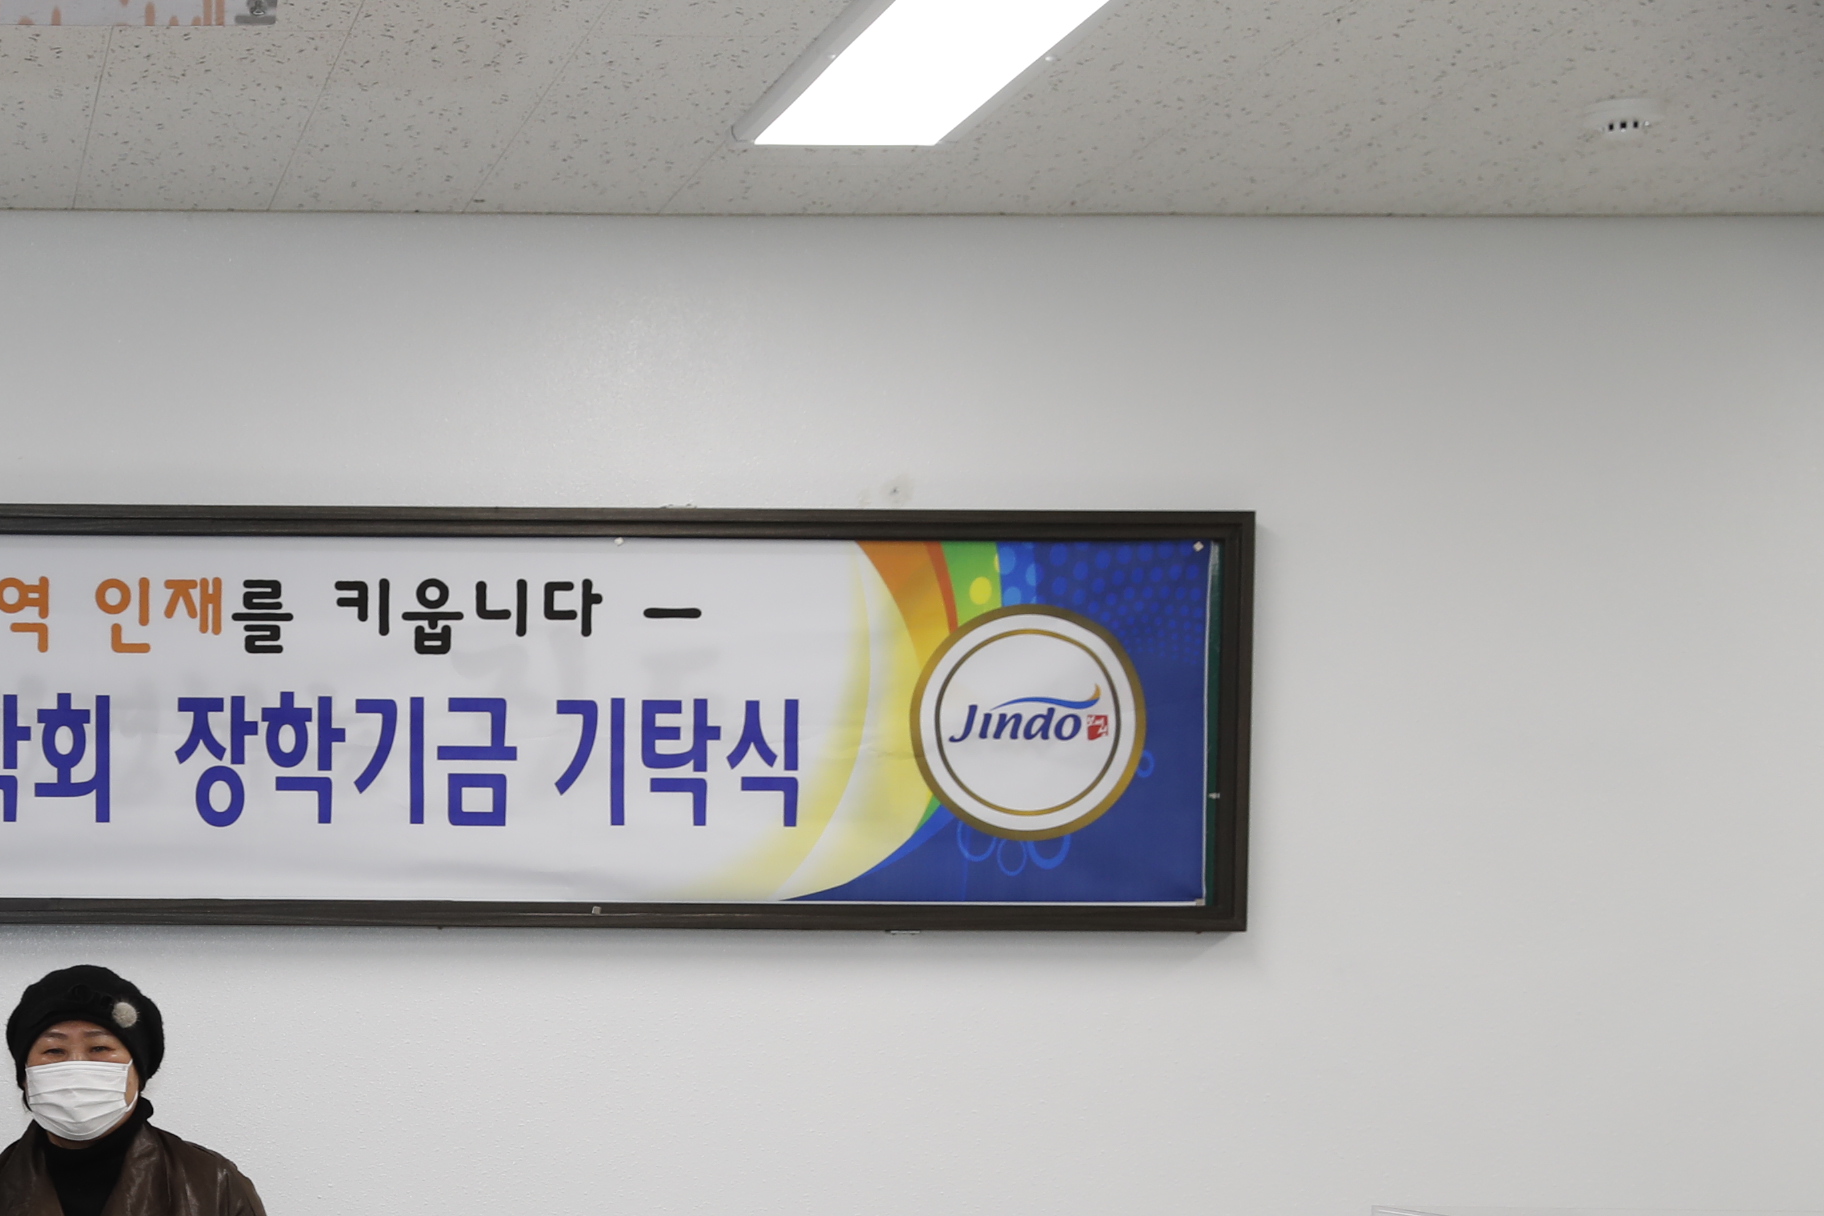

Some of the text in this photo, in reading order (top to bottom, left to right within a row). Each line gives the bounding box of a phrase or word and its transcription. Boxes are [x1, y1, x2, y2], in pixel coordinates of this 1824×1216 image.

[95, 577, 293, 654] 인재를
[335, 578, 603, 655] 키웁니다
[174, 691, 517, 828] 장학기금
[554, 697, 799, 828] 기탁식
[948, 703, 1083, 743] Jindo
